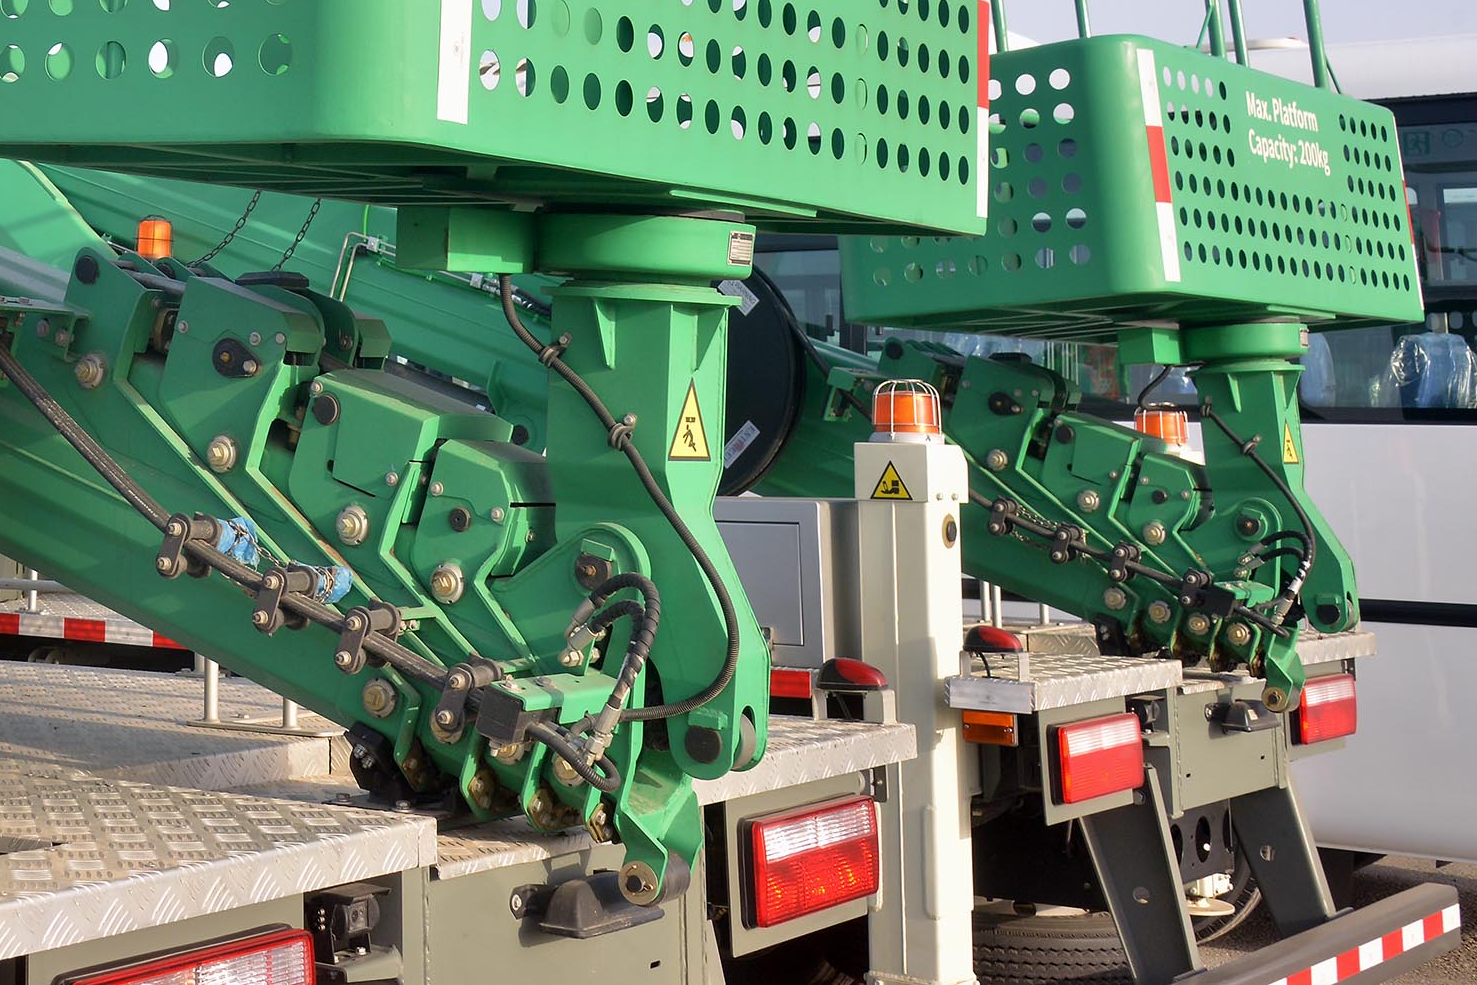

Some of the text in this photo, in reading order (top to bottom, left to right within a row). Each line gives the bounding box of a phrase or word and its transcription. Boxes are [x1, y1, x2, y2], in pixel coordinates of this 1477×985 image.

[1245, 90, 1319, 132] Max. Platform
[1248, 128, 1331, 176] Capacity: 200kg
